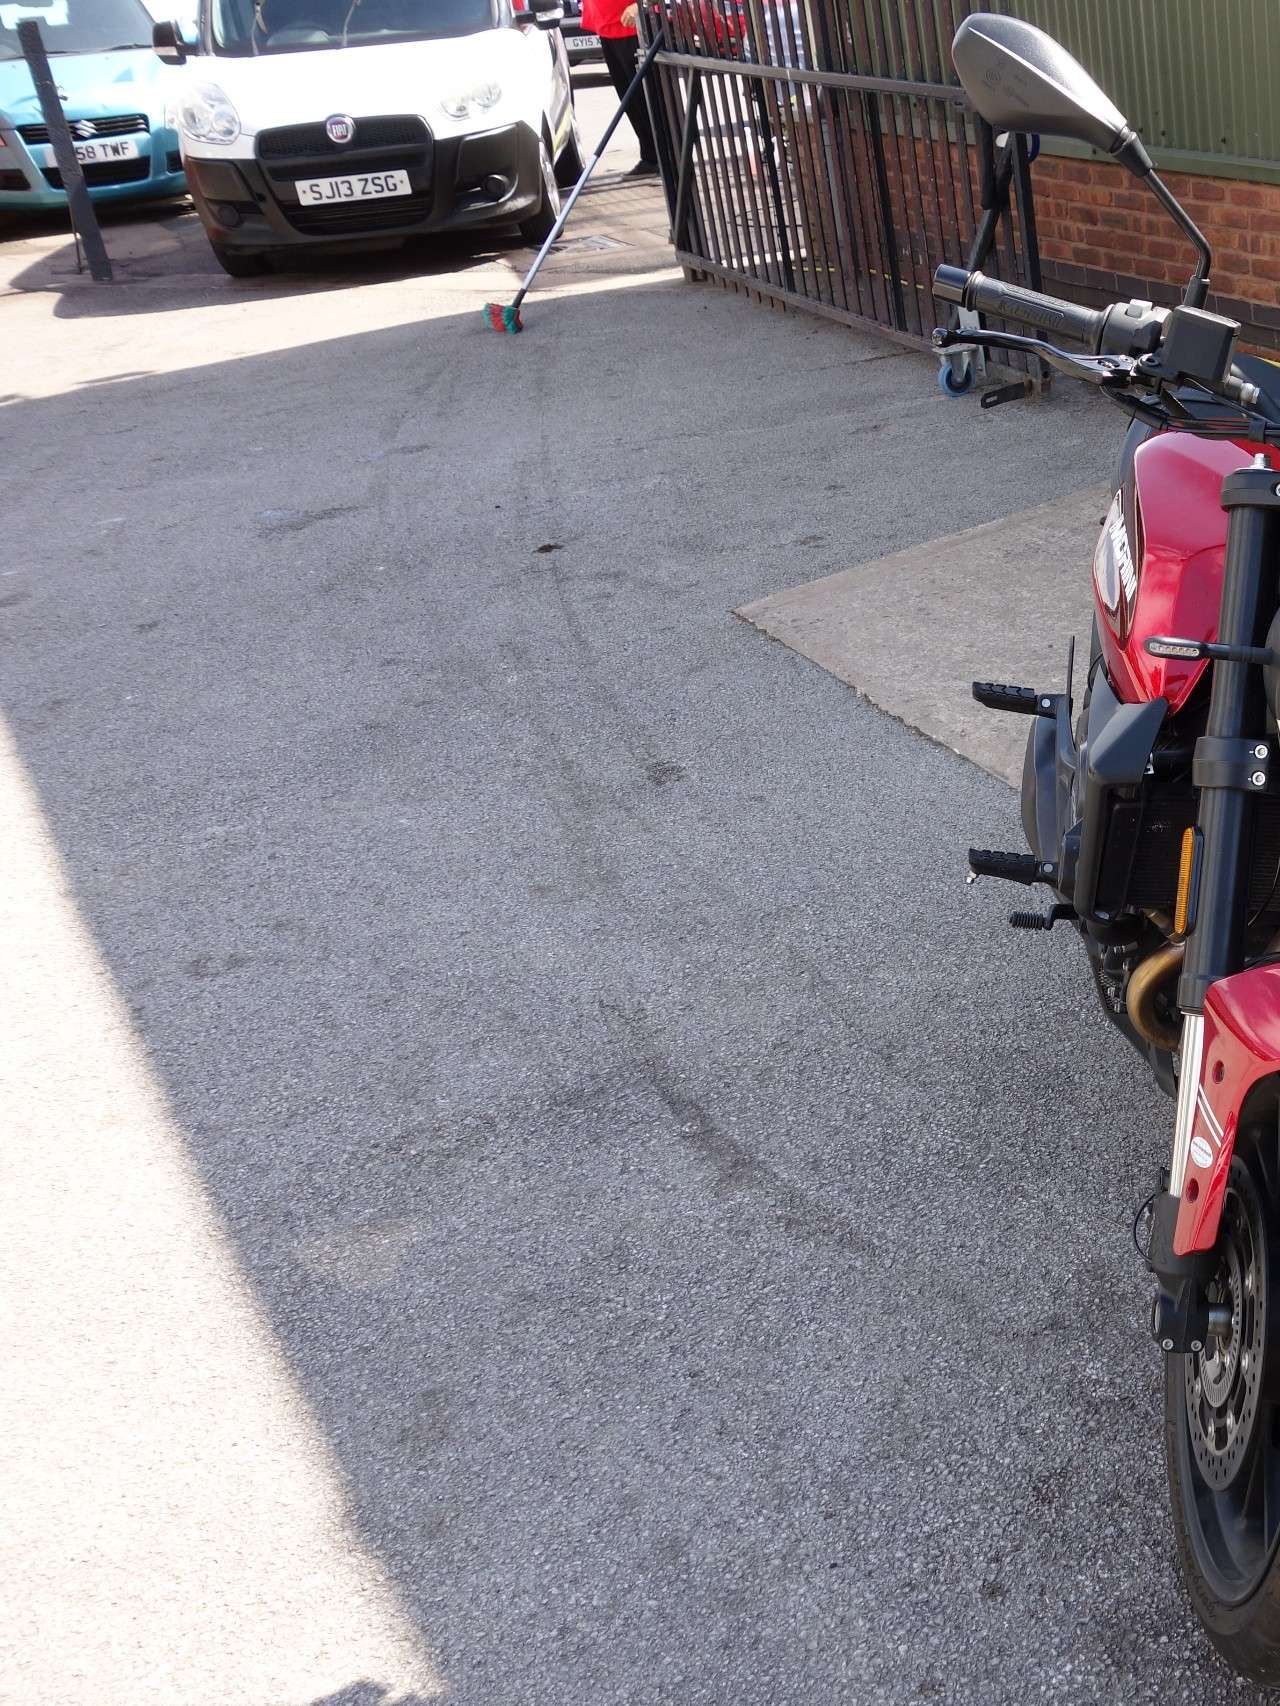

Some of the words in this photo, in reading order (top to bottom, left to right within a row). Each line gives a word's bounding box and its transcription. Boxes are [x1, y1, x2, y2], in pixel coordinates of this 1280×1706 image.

[572, 37, 594, 48] GY15
[331, 124, 347, 137] FIAT
[74, 145, 97, 161] 58
[99, 141, 129, 158] TWF
[308, 180, 354, 201] SJ13
[356, 174, 398, 196] ZSG
